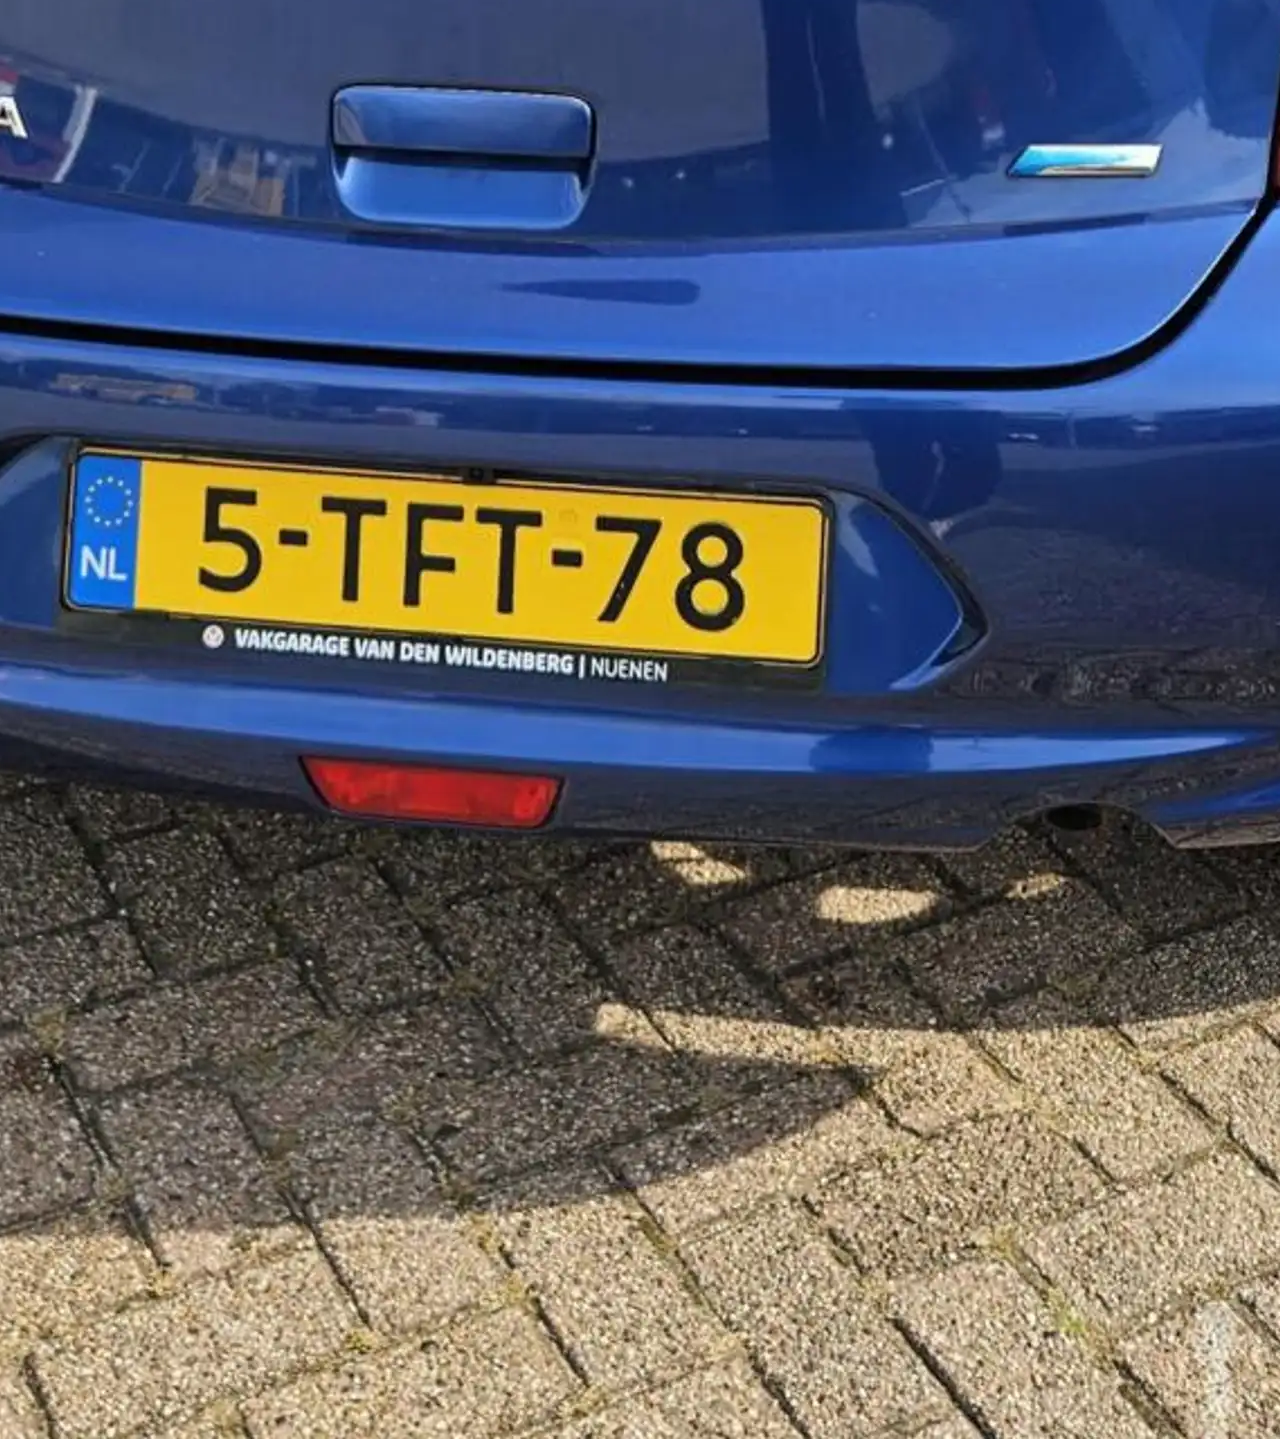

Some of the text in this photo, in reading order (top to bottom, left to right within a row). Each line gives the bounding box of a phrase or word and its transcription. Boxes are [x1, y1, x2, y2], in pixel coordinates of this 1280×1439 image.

[80, 546, 128, 581] NL
[198, 485, 746, 632] 5-TFT-78
[234, 627, 668, 682] VAKGARAGE VAN DEN WILDENBERG NUENEN
